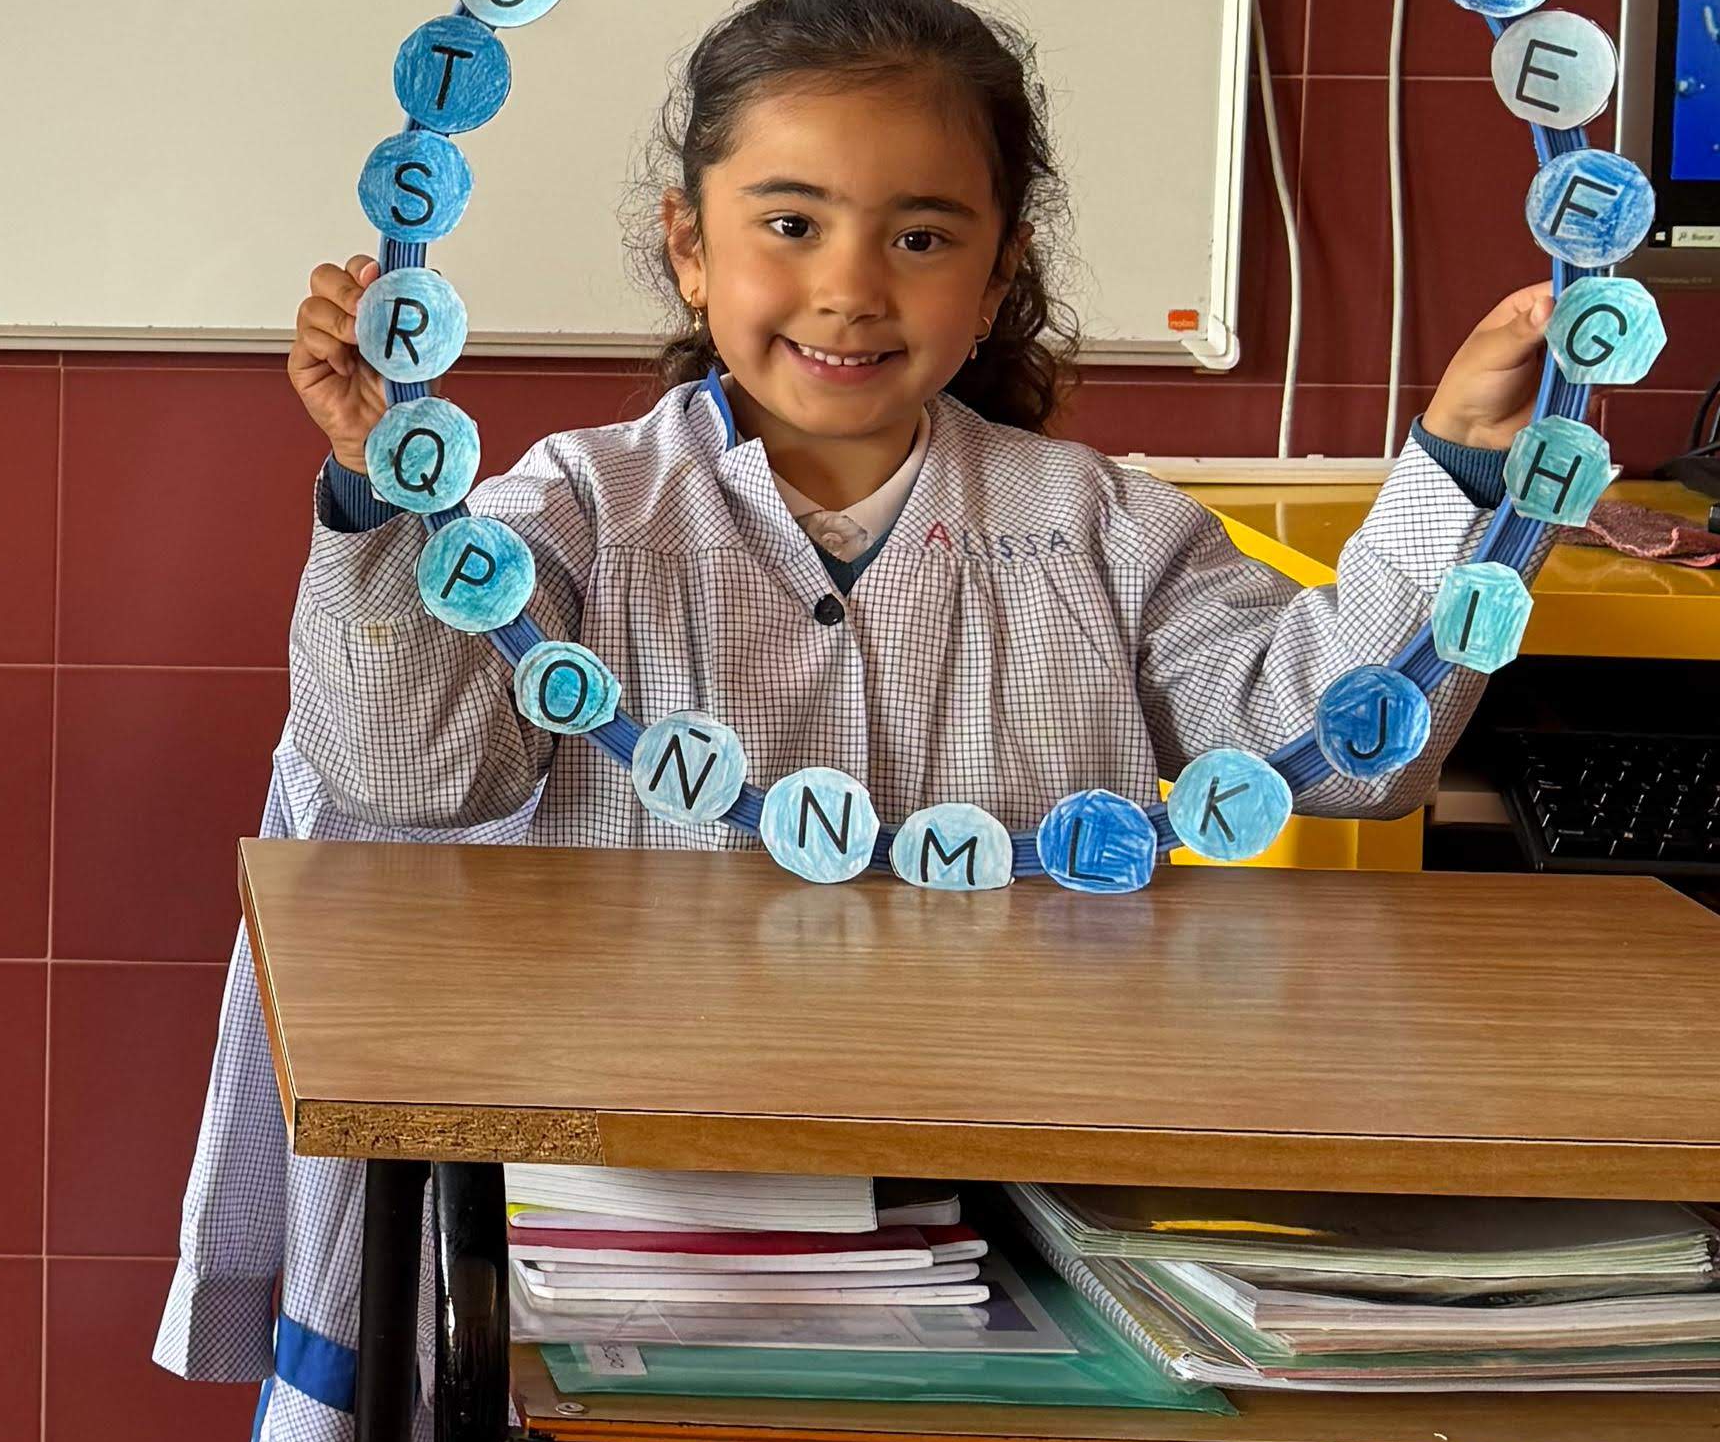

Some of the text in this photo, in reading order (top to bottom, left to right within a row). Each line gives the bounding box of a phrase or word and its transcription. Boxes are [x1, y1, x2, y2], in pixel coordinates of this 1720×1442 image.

[432, 45, 473, 109] T
[1516, 39, 1577, 112] E
[391, 163, 433, 226] S
[1550, 176, 1616, 236] F
[385, 297, 428, 365] R
[1566, 304, 1627, 367] G
[395, 428, 445, 497] Q
[1520, 441, 1581, 514] H
[441, 544, 495, 599] P
[924, 521, 1071, 559] ALISSA
[1459, 591, 1479, 651] I
[539, 660, 587, 724] O
[1347, 698, 1386, 759] J
[799, 787, 852, 854] N
[1200, 775, 1251, 843] K
[921, 828, 977, 885] M
[1067, 817, 1114, 883] L
